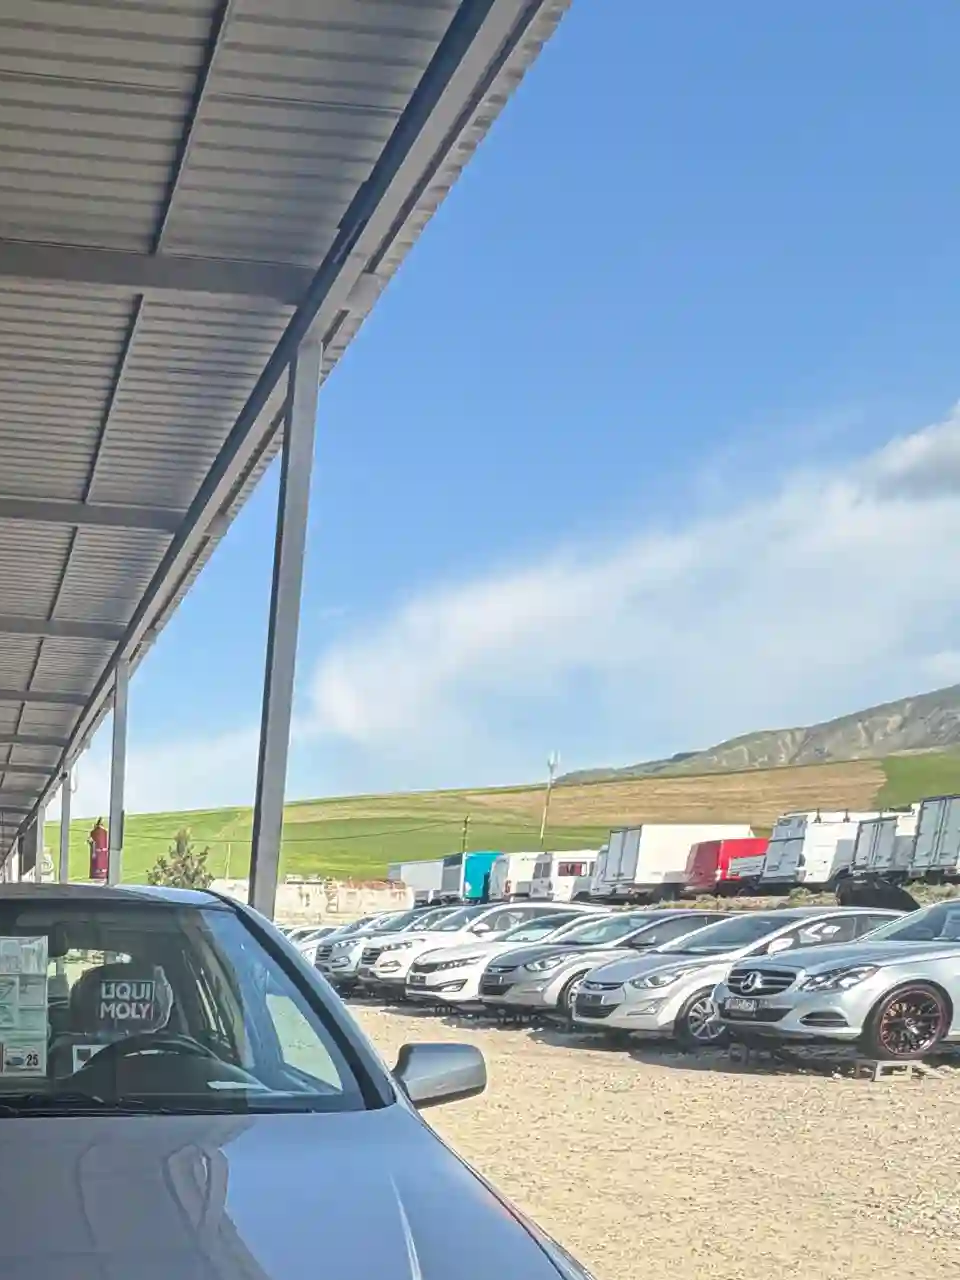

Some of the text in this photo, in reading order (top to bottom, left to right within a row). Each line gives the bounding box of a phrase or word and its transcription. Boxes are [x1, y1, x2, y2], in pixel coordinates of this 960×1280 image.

[101, 982, 151, 1000] LIQUI
[100, 1002, 150, 1019] MOLY
[26, 1054, 38, 1066] 25
